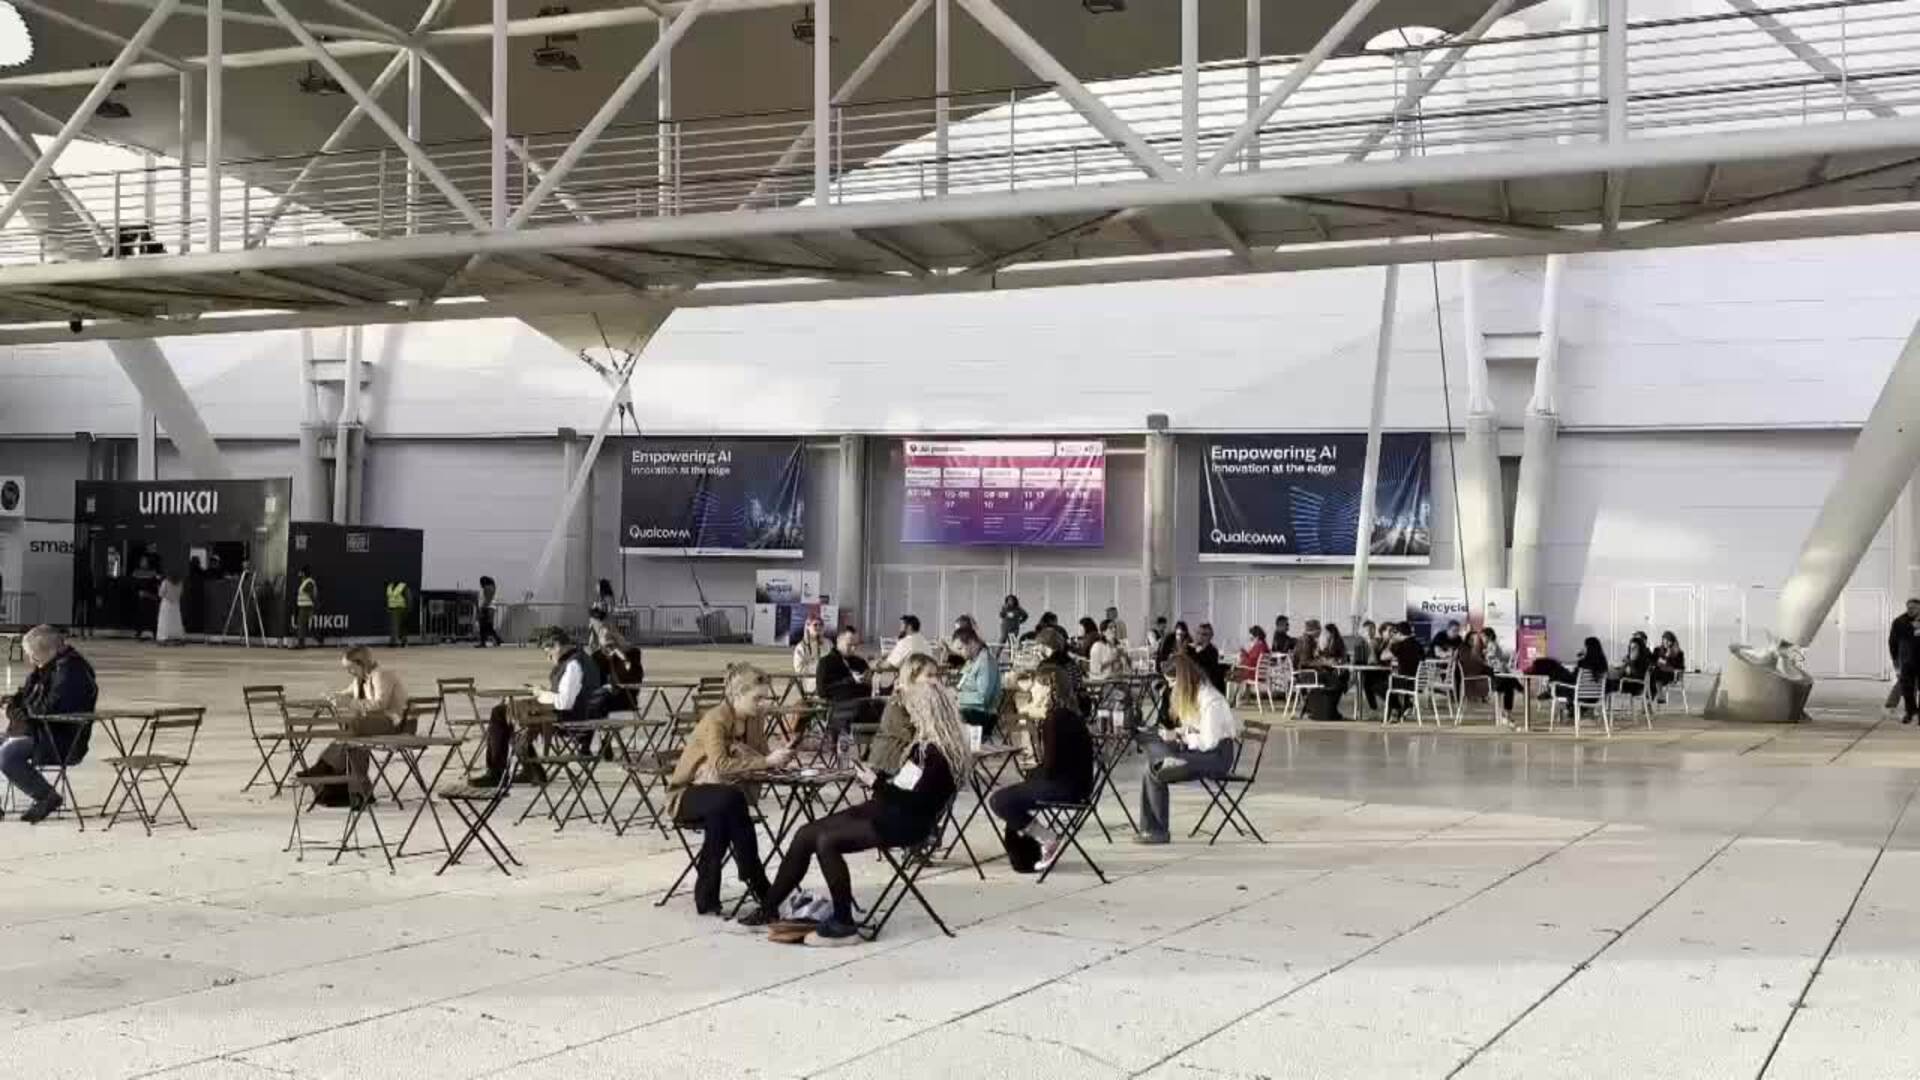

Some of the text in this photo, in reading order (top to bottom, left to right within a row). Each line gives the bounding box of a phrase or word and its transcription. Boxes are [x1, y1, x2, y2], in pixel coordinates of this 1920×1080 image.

[632, 450, 732, 465] Empowering AI
[1211, 445, 1337, 462] Empowering AI
[691, 466, 706, 475] the
[708, 467, 731, 476] edge
[1271, 464, 1284, 473] at
[1286, 463, 1305, 473] the
[1307, 463, 1336, 475] edge
[138, 489, 219, 515] umikai
[629, 525, 691, 539] Qualcomm
[1211, 529, 1287, 545] Qualcomm
[1421, 601, 1468, 614] Recycle
